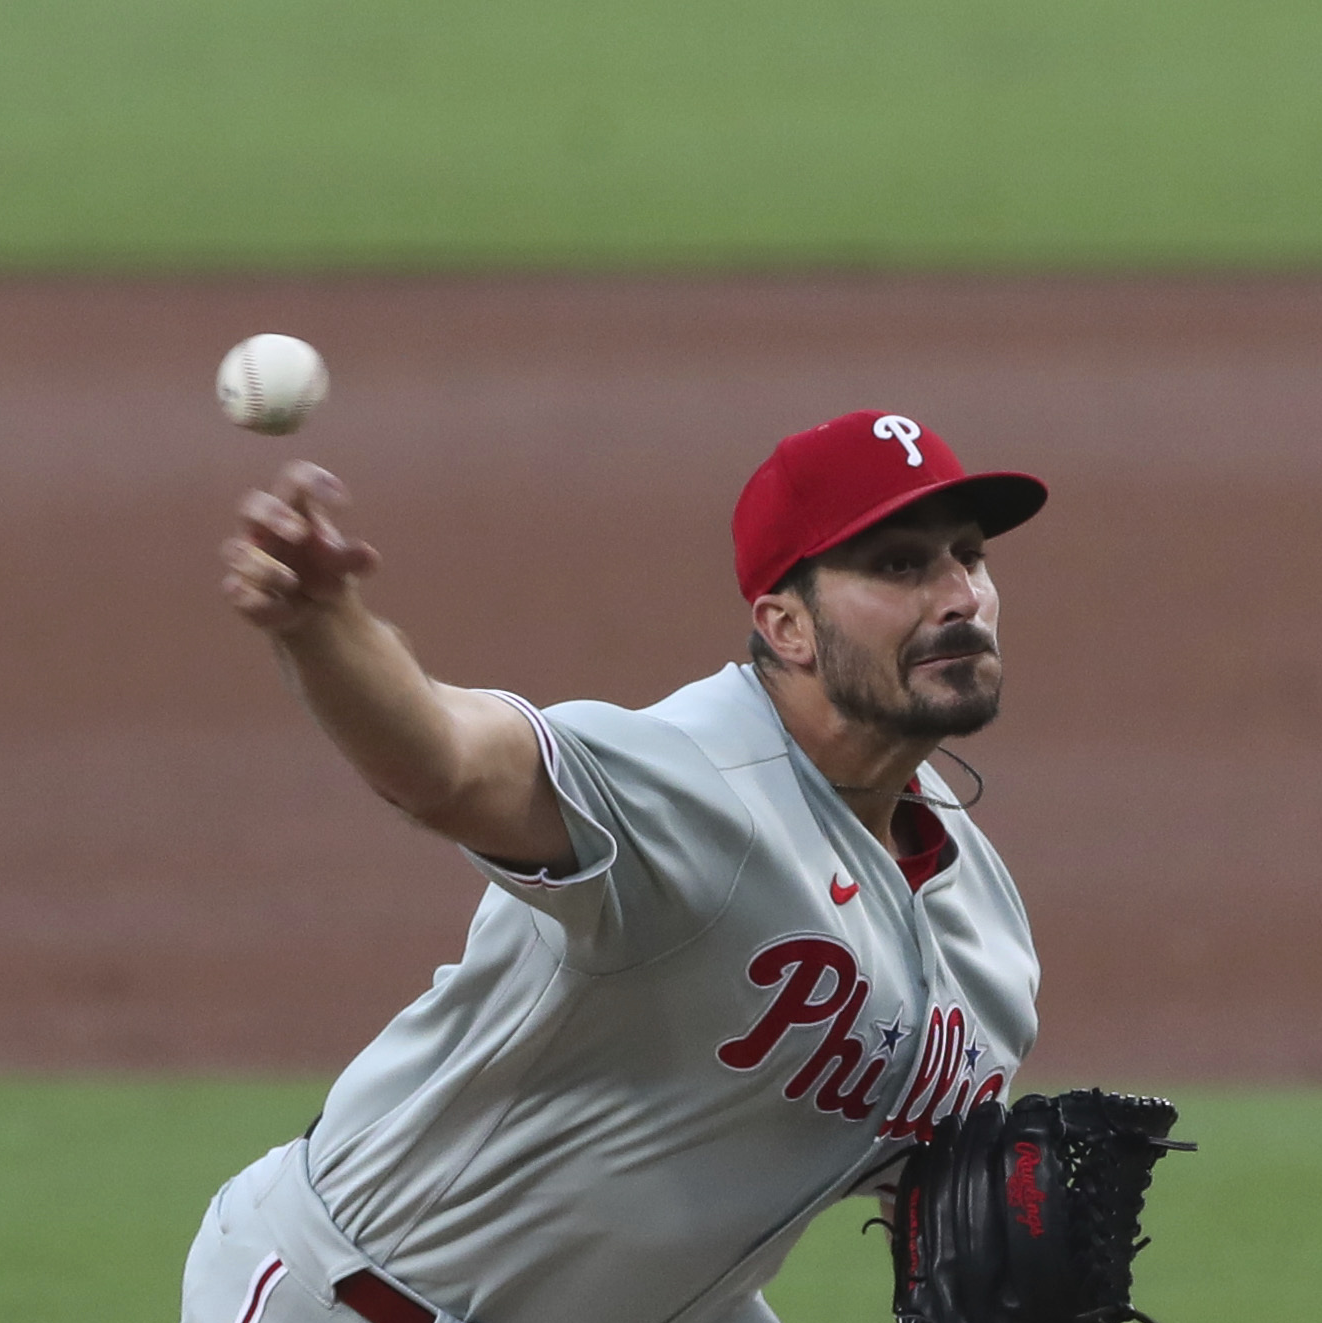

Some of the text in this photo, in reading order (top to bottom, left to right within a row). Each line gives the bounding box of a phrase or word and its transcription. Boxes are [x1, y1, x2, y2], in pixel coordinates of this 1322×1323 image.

[873, 415, 923, 467] P
[716, 931, 1006, 1142] Philli
[1014, 1142, 1048, 1237] Rawlings
